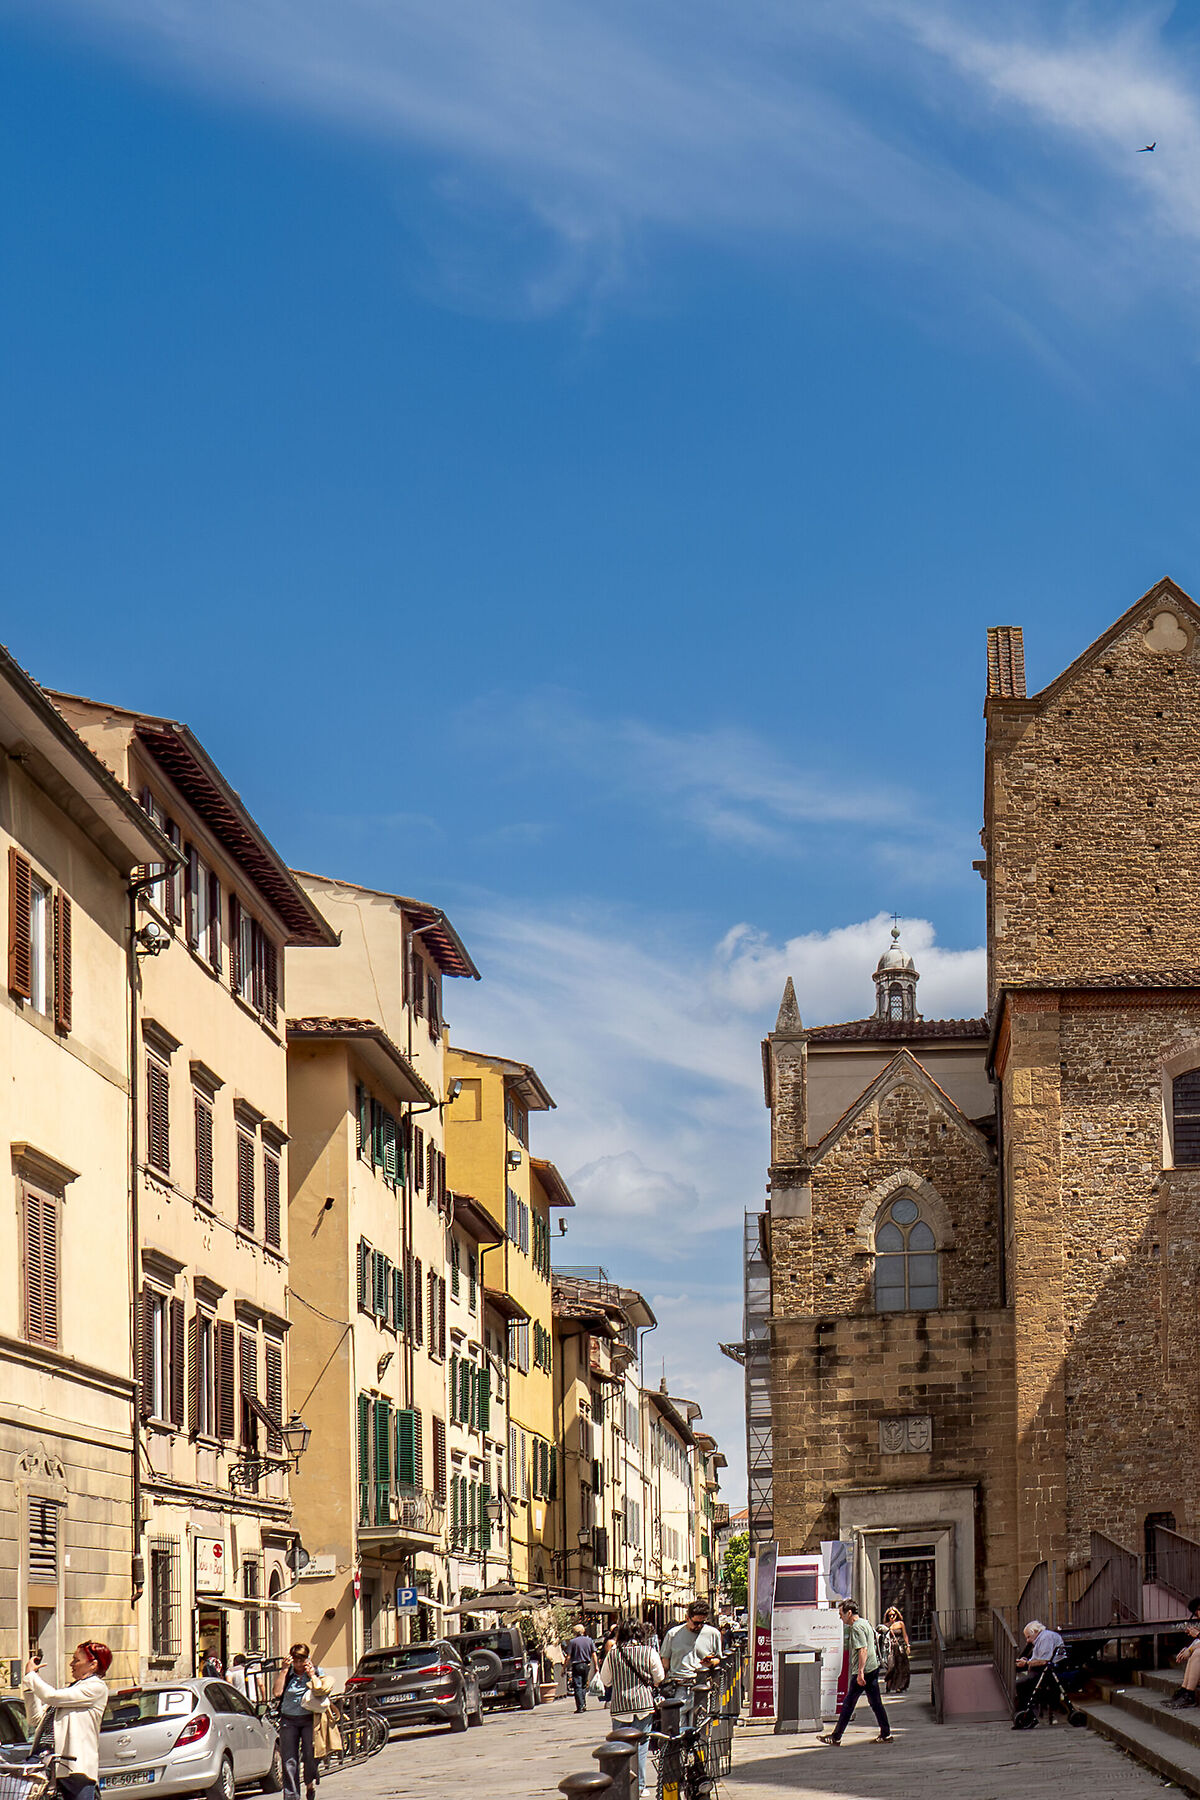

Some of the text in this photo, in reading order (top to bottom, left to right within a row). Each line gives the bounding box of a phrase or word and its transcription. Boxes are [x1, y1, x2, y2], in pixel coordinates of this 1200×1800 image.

[401, 1590, 413, 1605] P
[473, 1664, 490, 1674] Jeep
[165, 1693, 185, 1711] P
